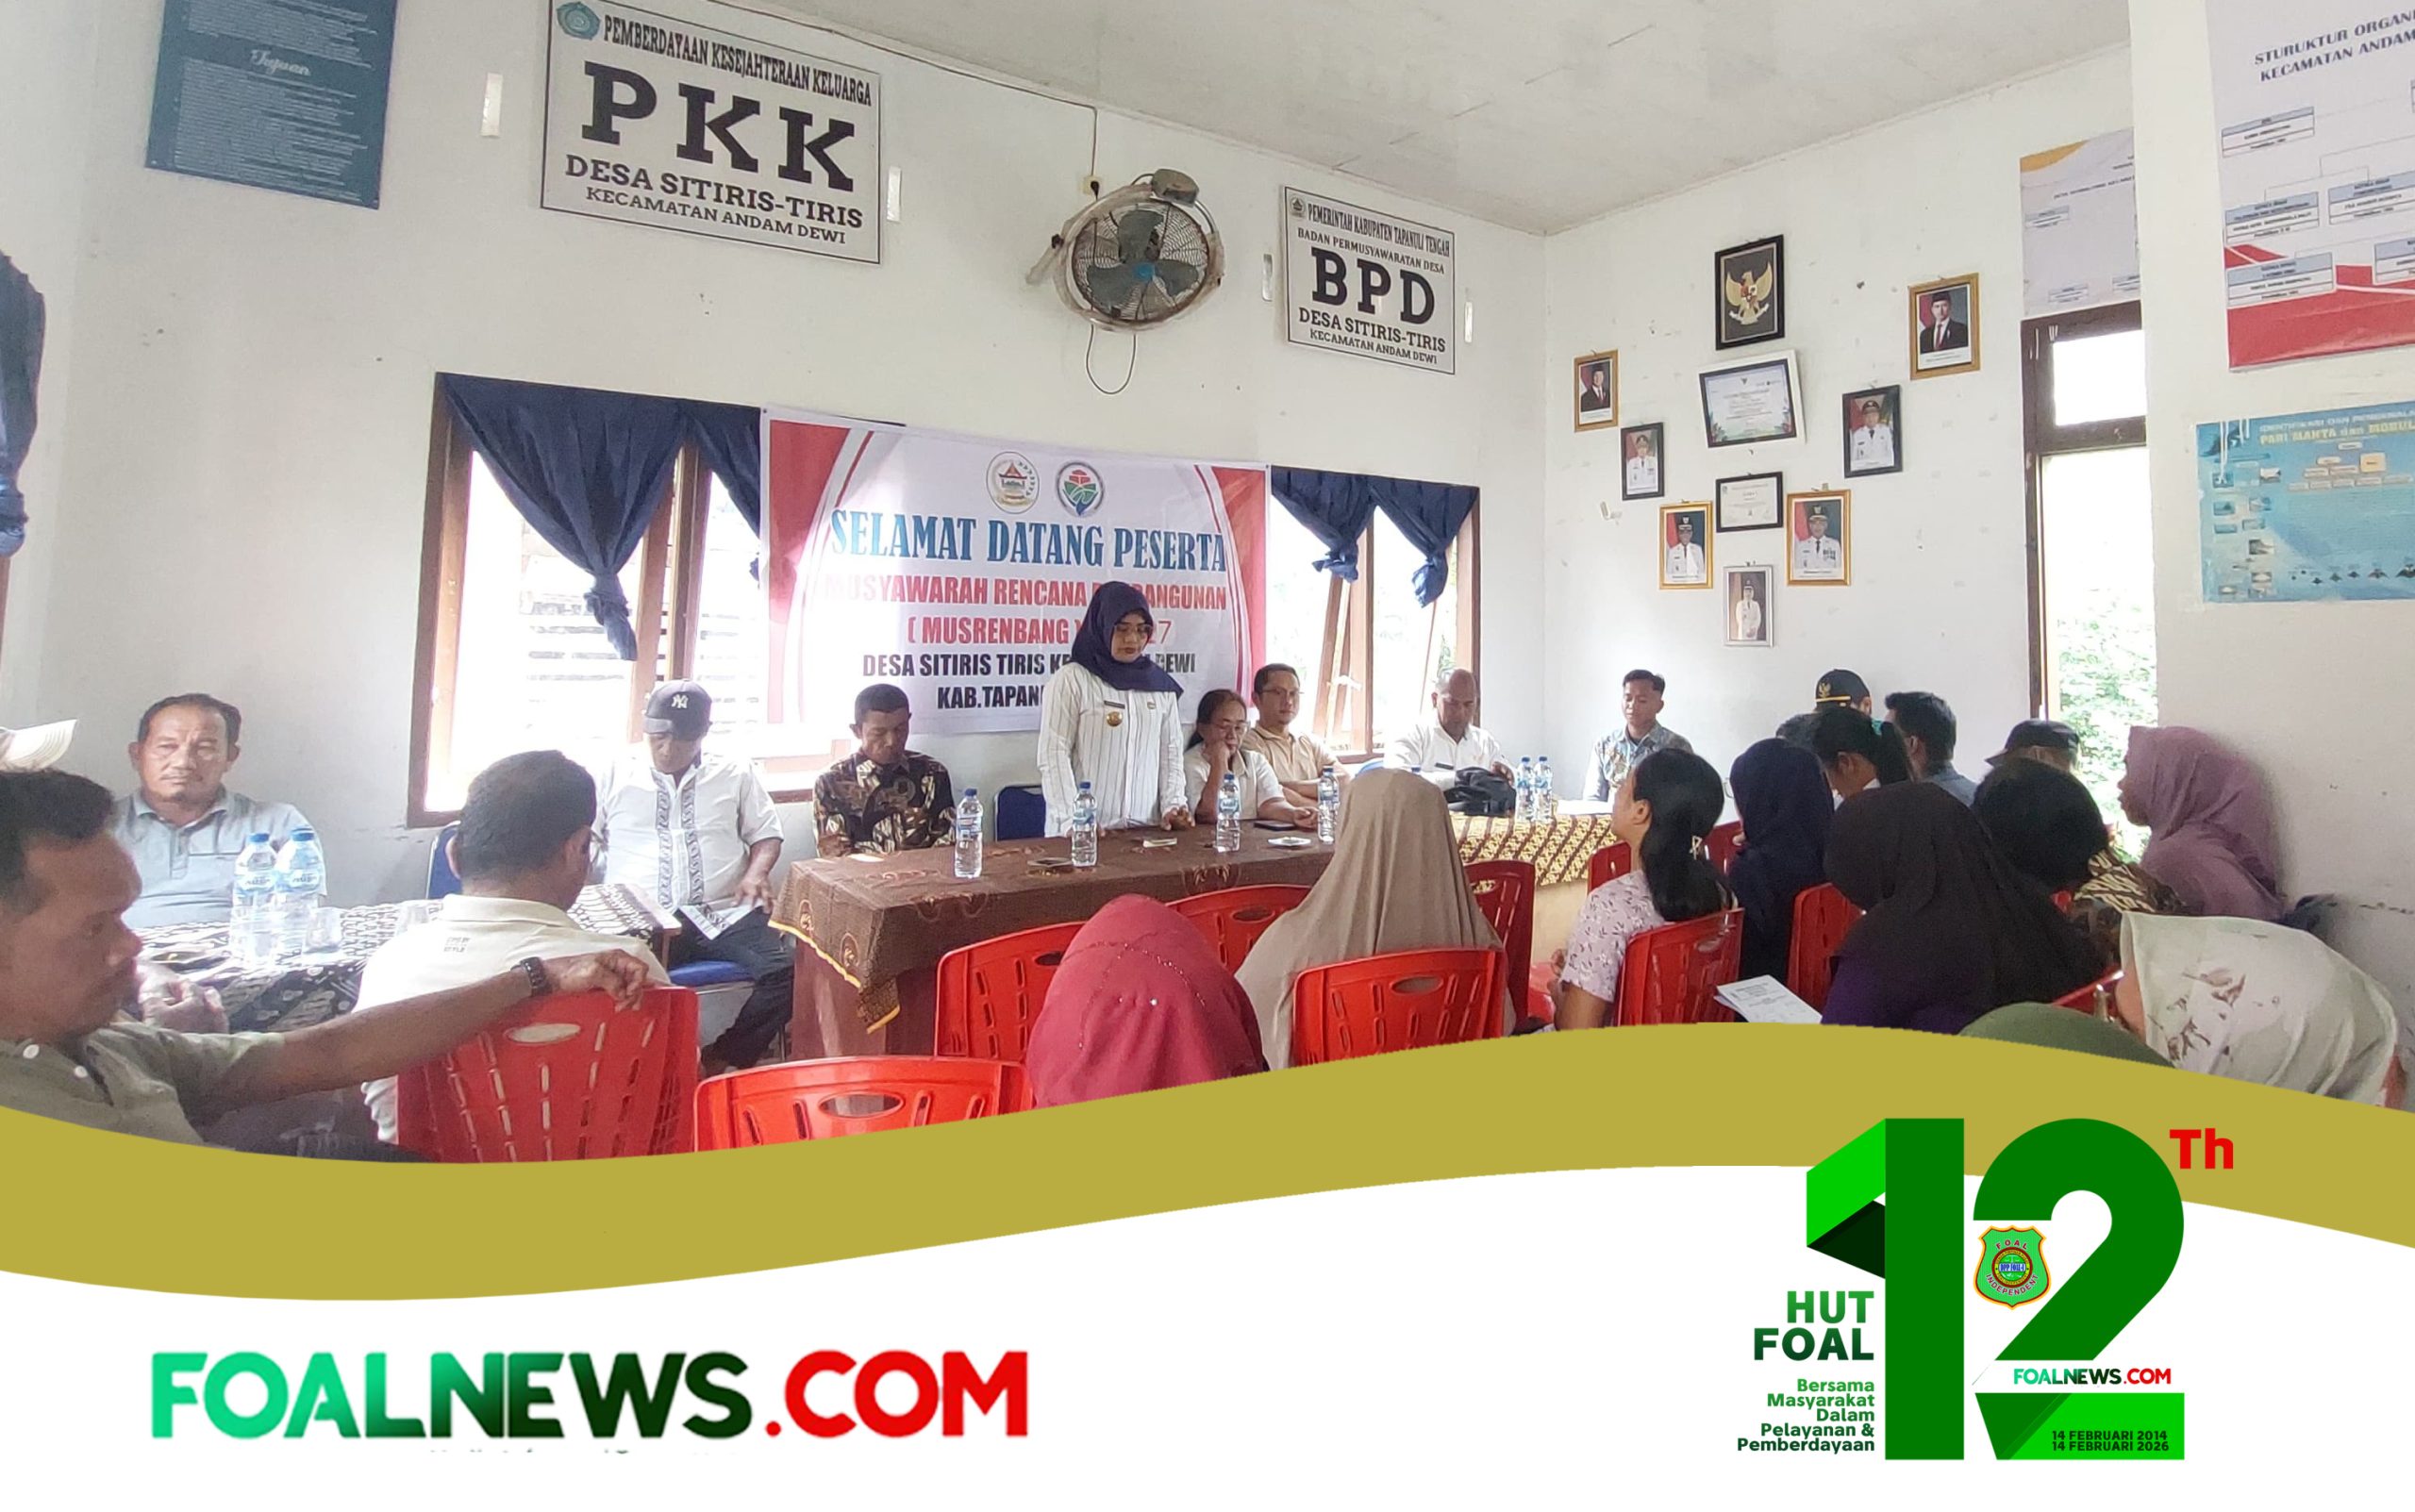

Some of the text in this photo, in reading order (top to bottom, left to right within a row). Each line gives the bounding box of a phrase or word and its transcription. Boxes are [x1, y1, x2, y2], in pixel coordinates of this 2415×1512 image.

[603, 14, 872, 107] PEMBERDAYAAN KESEJAHTERAAN KELUARGA
[2260, 47, 2353, 82] KECAMATAN
[581, 60, 855, 192] PKK
[565, 153, 863, 229] DESA SITIRIS-TIRIS
[586, 186, 846, 244] KECAMATAN ANDAM DEWI
[1307, 203, 1450, 258] PEMERINTAH KABUPATEN TAPANULI TENGAH
[1297, 227, 1445, 274] BADAN PERMUSYAWARATAN DESA
[1311, 246, 1435, 324] BPD
[1299, 307, 1446, 353] DESA SITIRIS-TIRIS
[1309, 328, 1438, 365] KECAMATAN ANDAM DEWI
[2292, 428, 2337, 442] MANTA
[831, 508, 1226, 573] SELAMAT DATANG PESERTA
[824, 573, 988, 605] MUSYAWARAH
[993, 578, 1088, 606] RENCANA
[922, 616, 1069, 644] MUSRENBANG
[862, 653, 915, 677] DESA
[919, 653, 991, 677] SITIRIS
[996, 653, 1045, 676] TIRIS
[937, 684, 1044, 709] KAB.TAPAN
